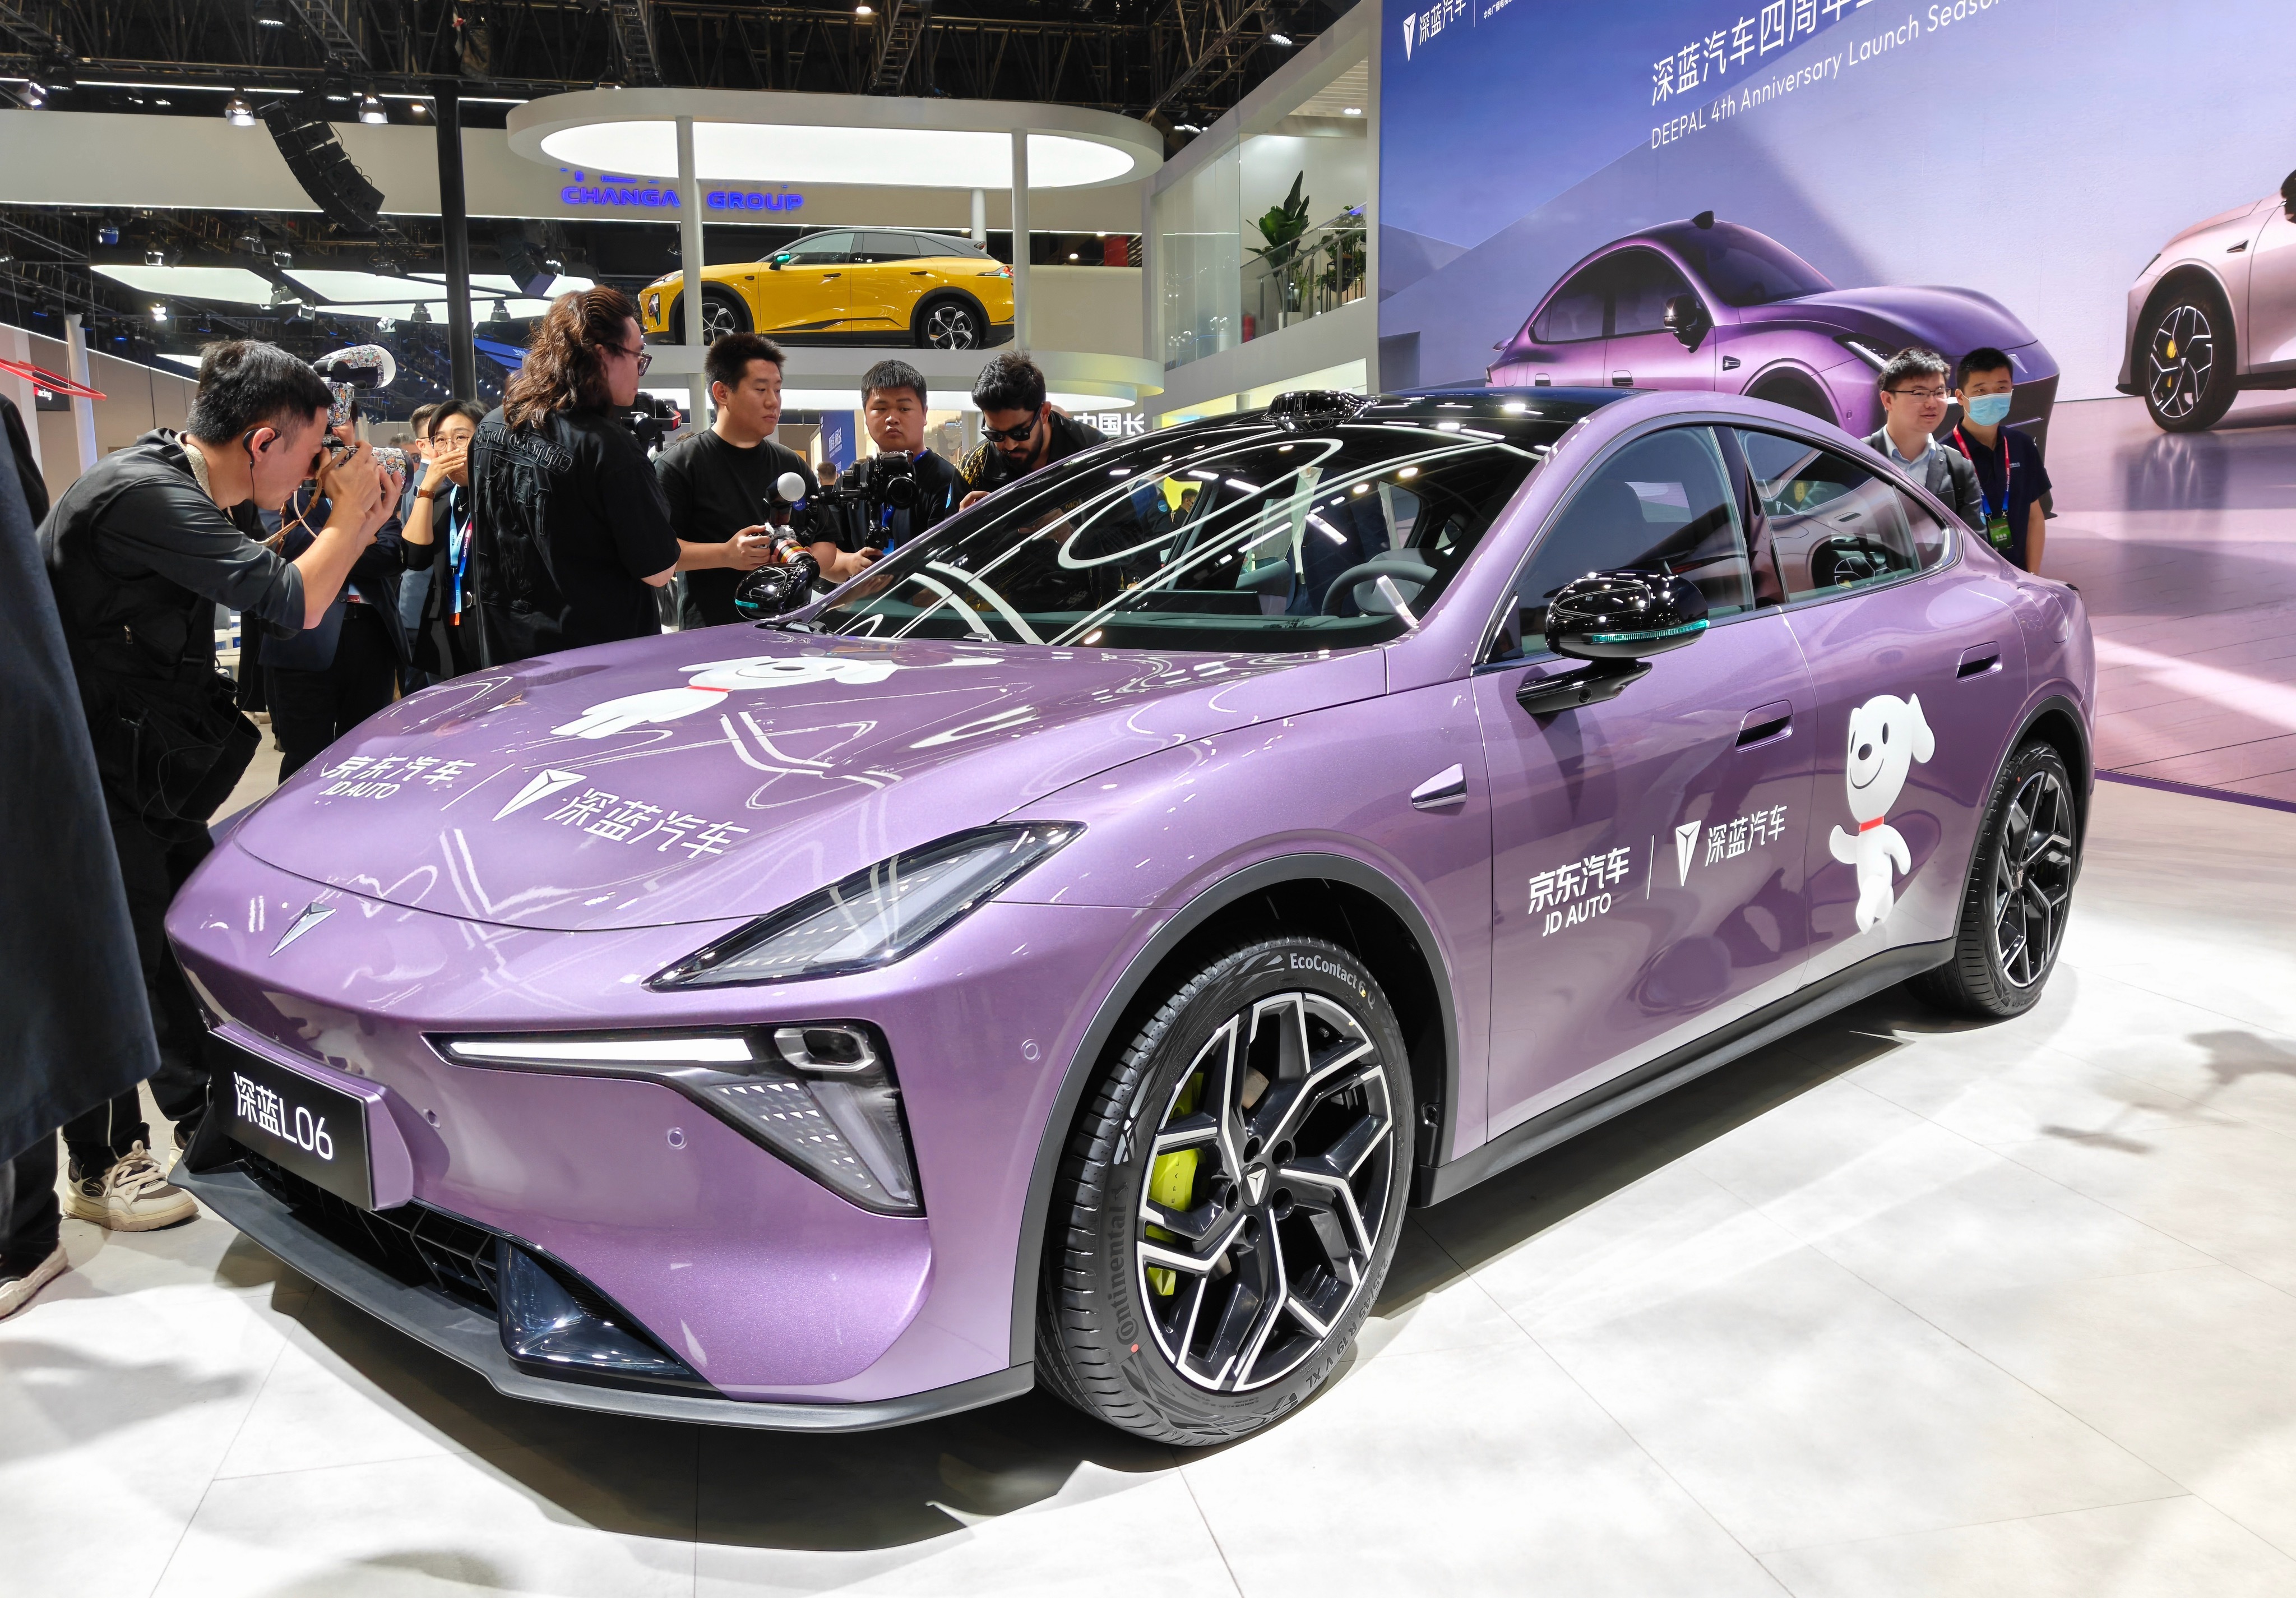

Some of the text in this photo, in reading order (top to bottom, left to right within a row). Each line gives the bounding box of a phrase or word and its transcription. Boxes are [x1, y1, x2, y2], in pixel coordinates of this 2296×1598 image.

[1652, 0, 1878, 105] 深蓝汽车四周
[1652, 0, 2007, 149] DEEPAL 4th Anniversary Launch Seaso
[562, 186, 804, 211] CHANGA GROUP
[318, 781, 401, 800] JD AUTO
[320, 756, 477, 785] 京东汽车
[543, 787, 751, 858] 深蓝汽车
[1705, 804, 1788, 867] 深蓝汽车
[1528, 847, 1631, 914] 京东汽车
[1543, 892, 1612, 937] JD AUTO
[1290, 953, 1358, 989] EcoContact
[233, 1072, 334, 1161] 深蓝L06
[1108, 1206, 1139, 1345] Continental
[1336, 1336, 1349, 1355] 19
[1348, 1322, 1358, 1337] R
[1306, 1366, 1321, 1389] XL
[1325, 1356, 1334, 1371] V
